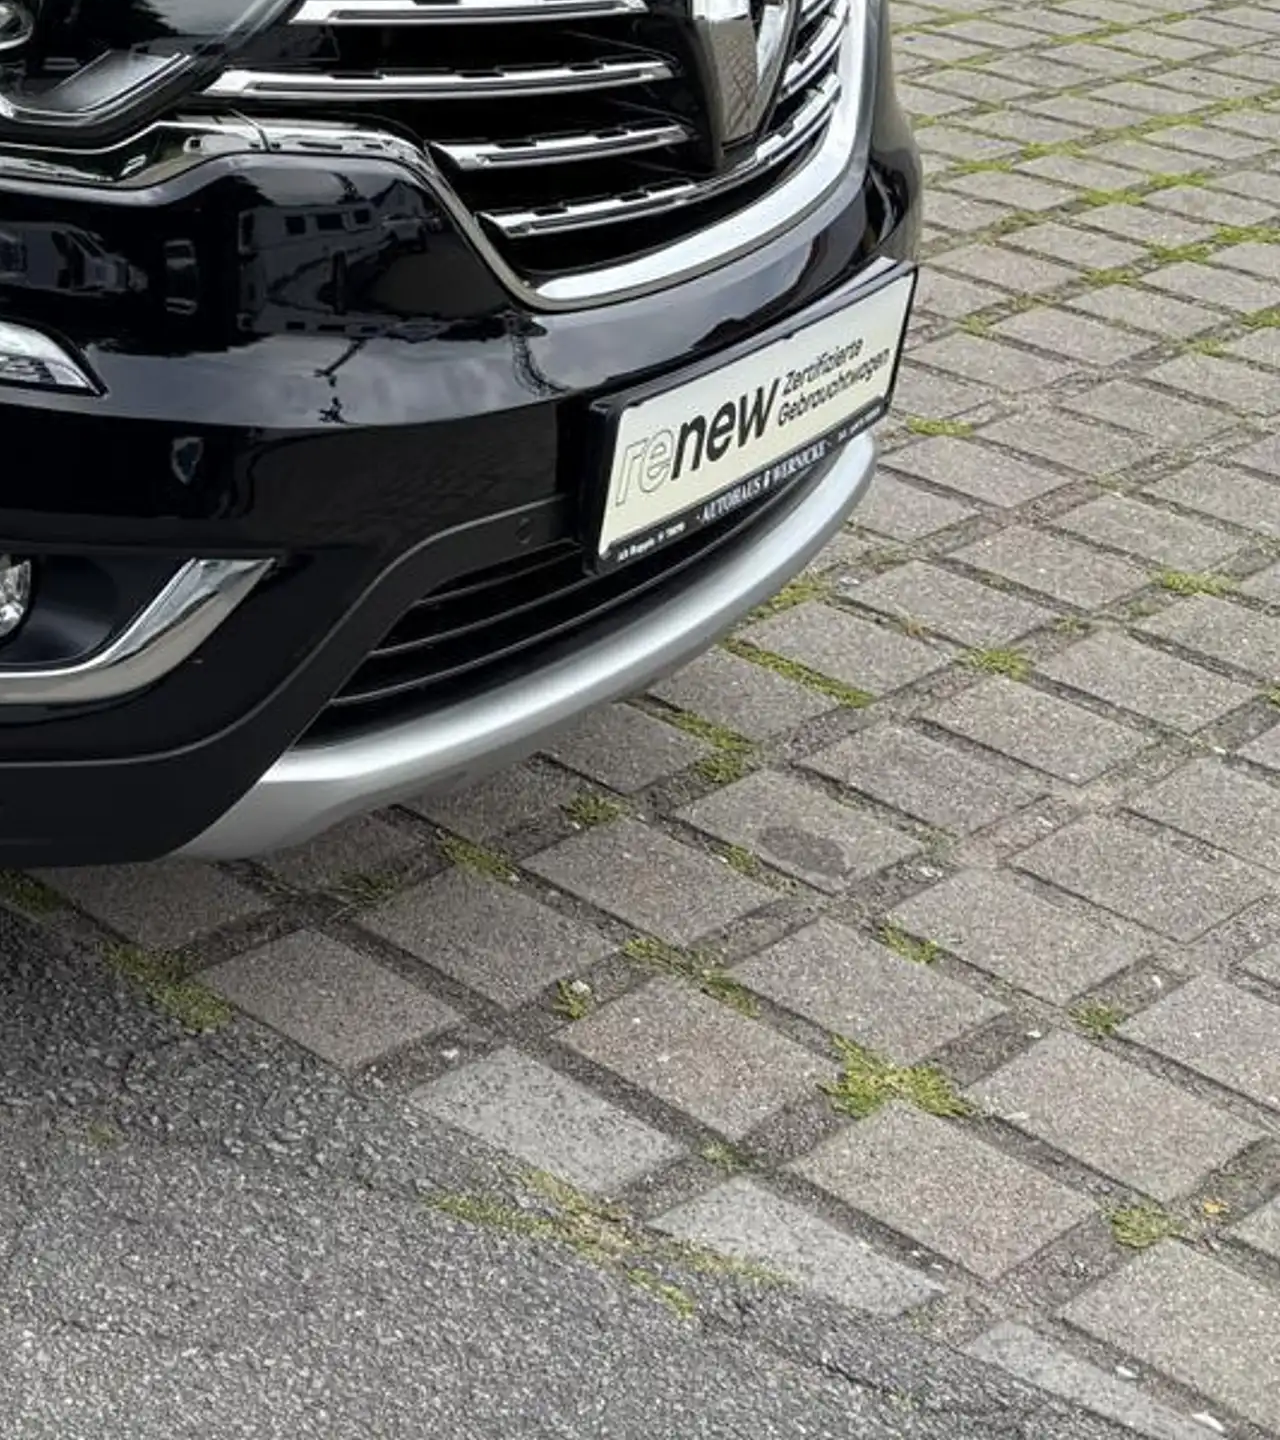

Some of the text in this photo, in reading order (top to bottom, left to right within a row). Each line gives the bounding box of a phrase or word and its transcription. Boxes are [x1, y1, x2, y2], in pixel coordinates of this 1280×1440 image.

[778, 347, 891, 427] Gebrauchtwagen
[783, 338, 864, 396] Zertifizierte
[615, 377, 781, 508] renew
